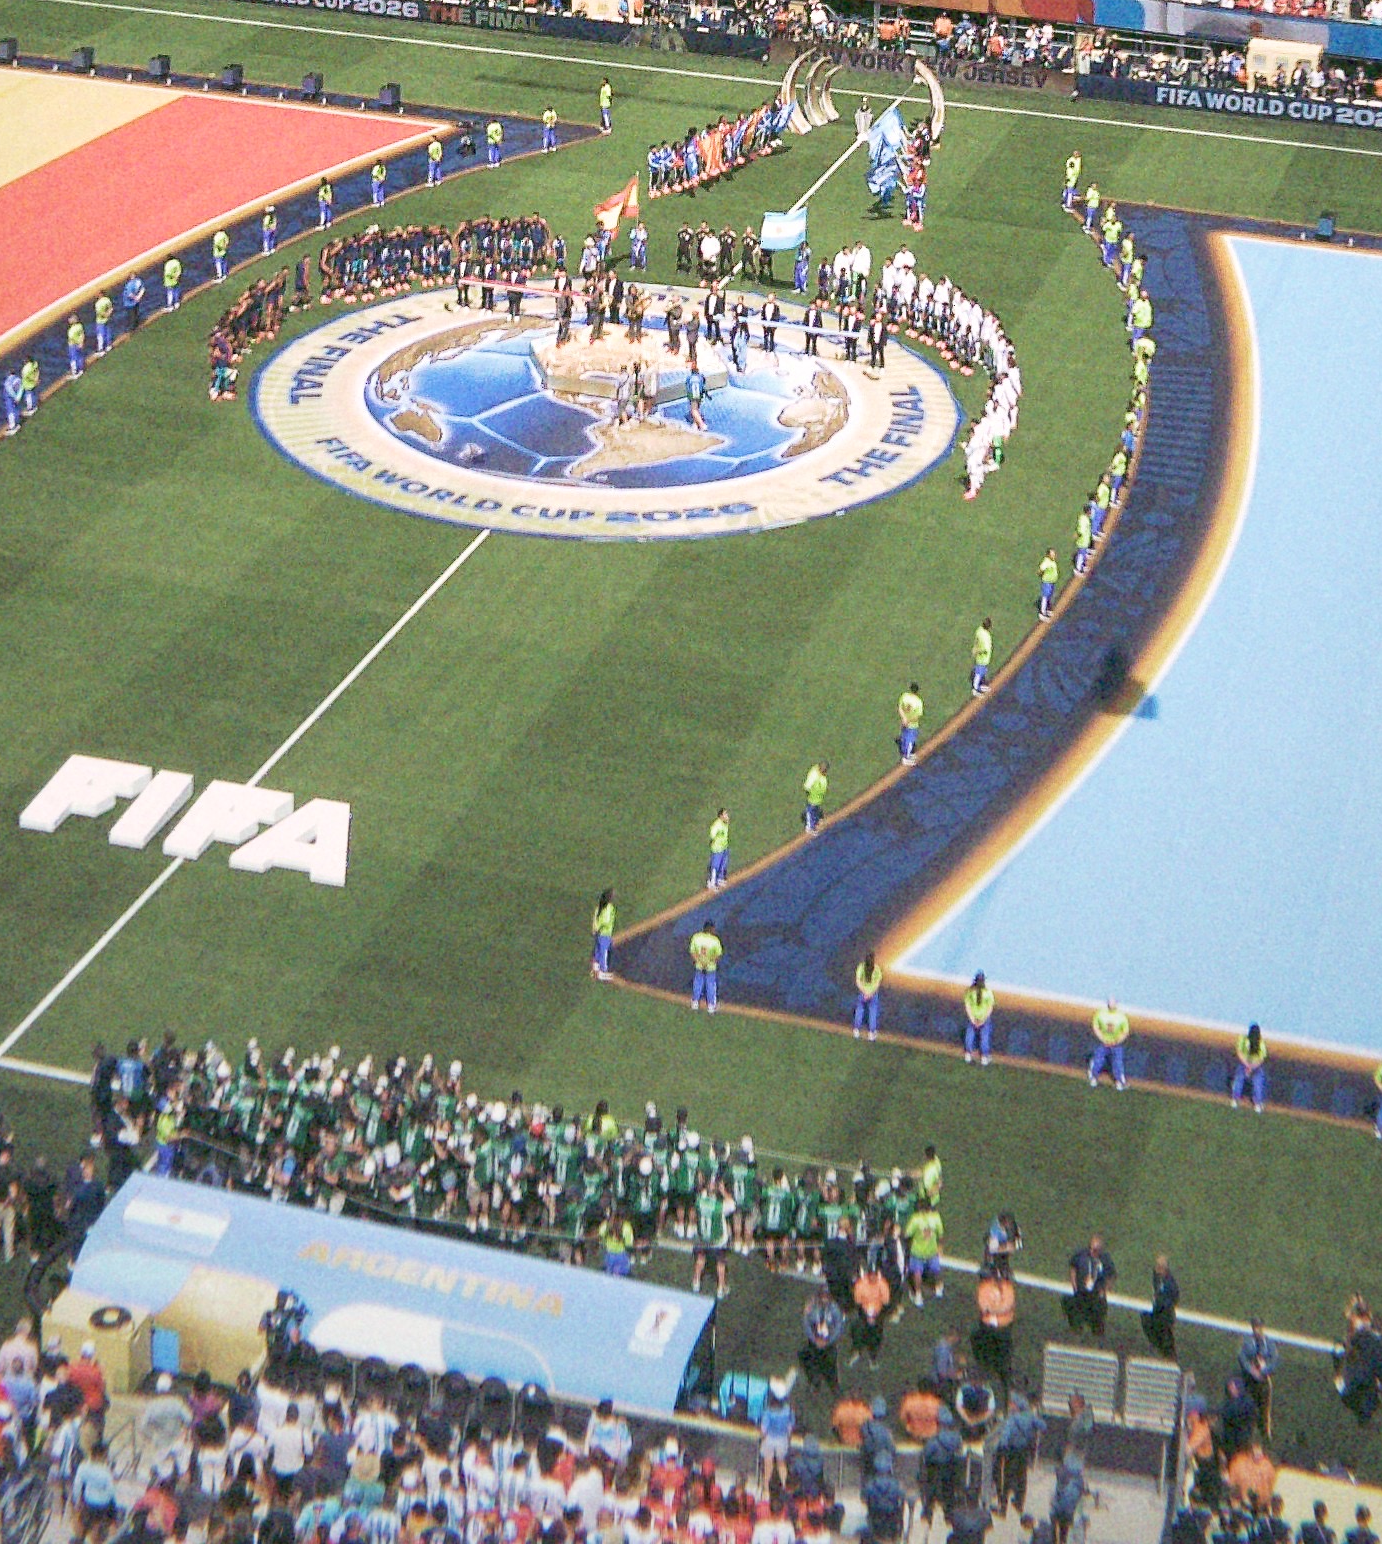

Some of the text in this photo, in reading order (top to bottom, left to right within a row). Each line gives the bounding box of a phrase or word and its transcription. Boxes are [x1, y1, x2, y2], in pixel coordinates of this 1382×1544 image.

[962, 64, 1049, 89] JERSEY
[1155, 86, 1203, 108] FIFA
[1203, 91, 1285, 118] WORLD
[1287, 99, 1333, 122] CUP
[289, 313, 424, 405] THE FINAL
[817, 383, 925, 487] THE FINAL
[315, 436, 758, 524] FIFA WORLD CUP 2026
[19, 753, 352, 888] FIFA
[297, 1240, 563, 1319] ARGENTINA
